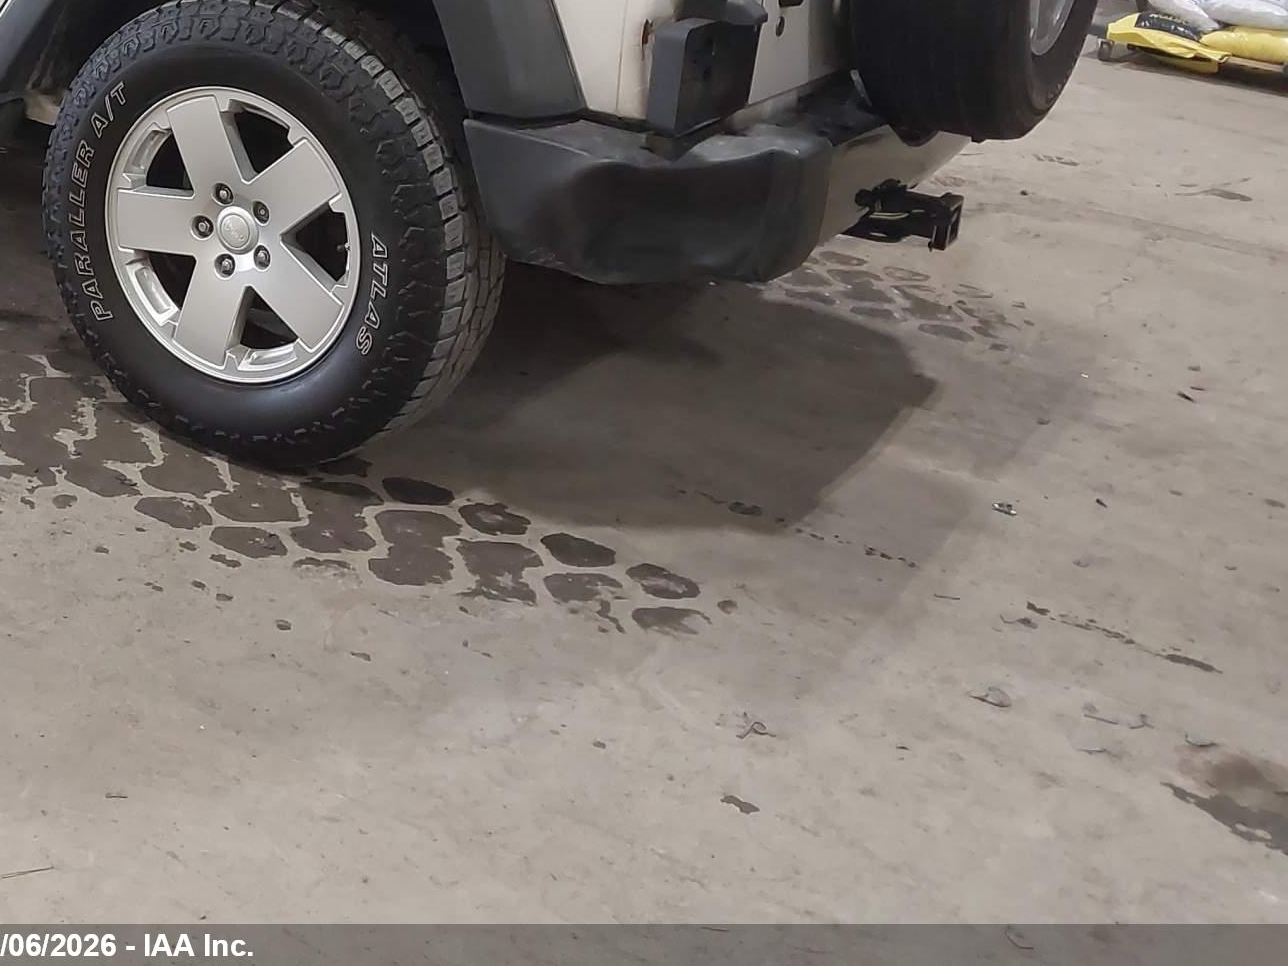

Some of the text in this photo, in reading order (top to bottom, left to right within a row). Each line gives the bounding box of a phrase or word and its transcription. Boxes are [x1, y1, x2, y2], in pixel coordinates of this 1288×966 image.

[69, 81, 127, 321] PARALLER A/T
[355, 231, 389, 355] ATLAS
